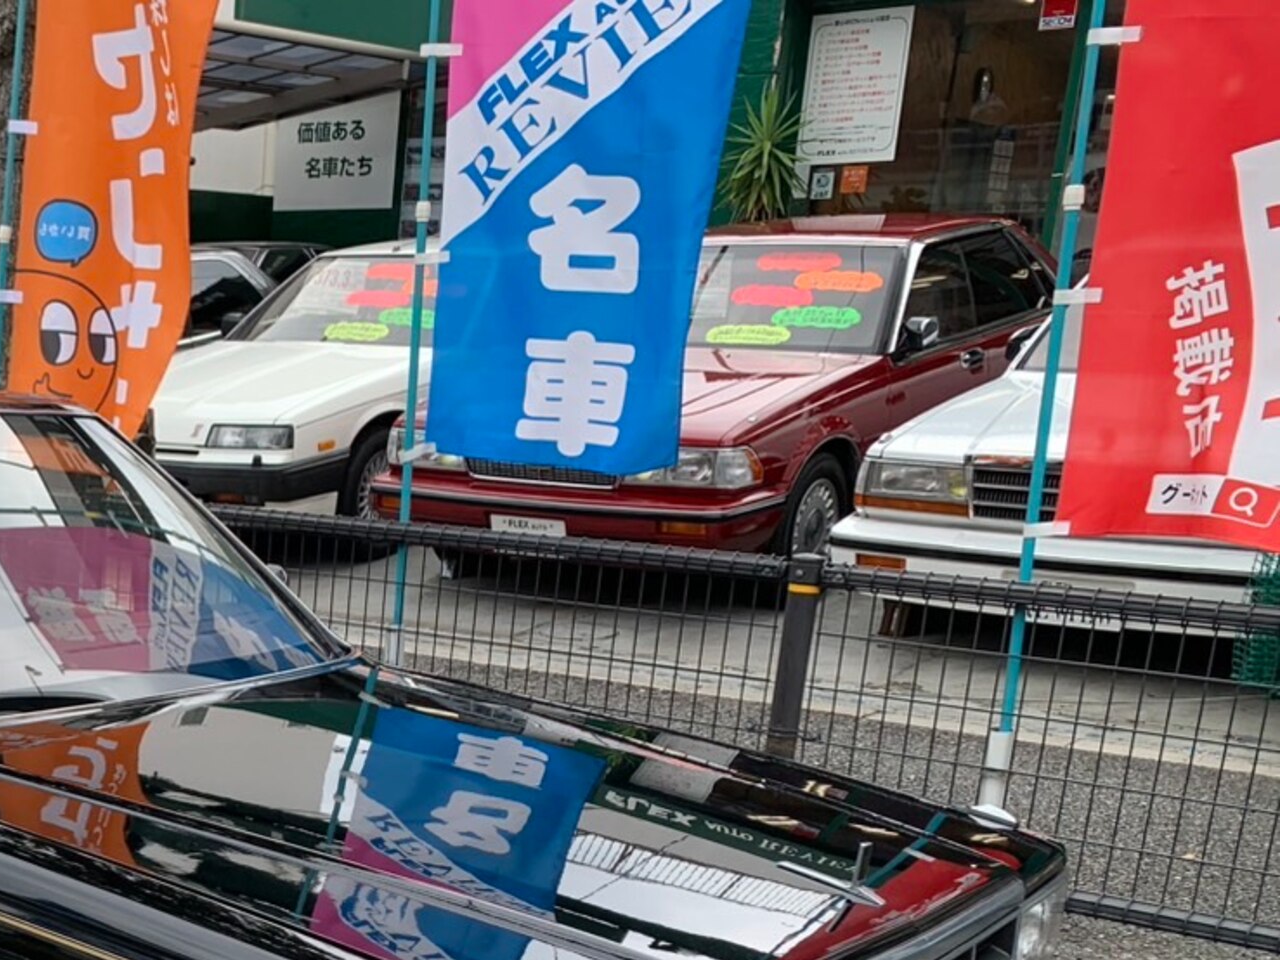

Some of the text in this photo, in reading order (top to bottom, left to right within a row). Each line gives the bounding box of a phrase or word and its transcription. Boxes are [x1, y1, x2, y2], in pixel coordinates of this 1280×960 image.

[477, 13, 589, 125] FLEX
[298, 120, 366, 144] 価値ある
[305, 156, 373, 179] 名車たち
[515, 163, 641, 457] 名車
[1166, 260, 1234, 458] 掲載店
